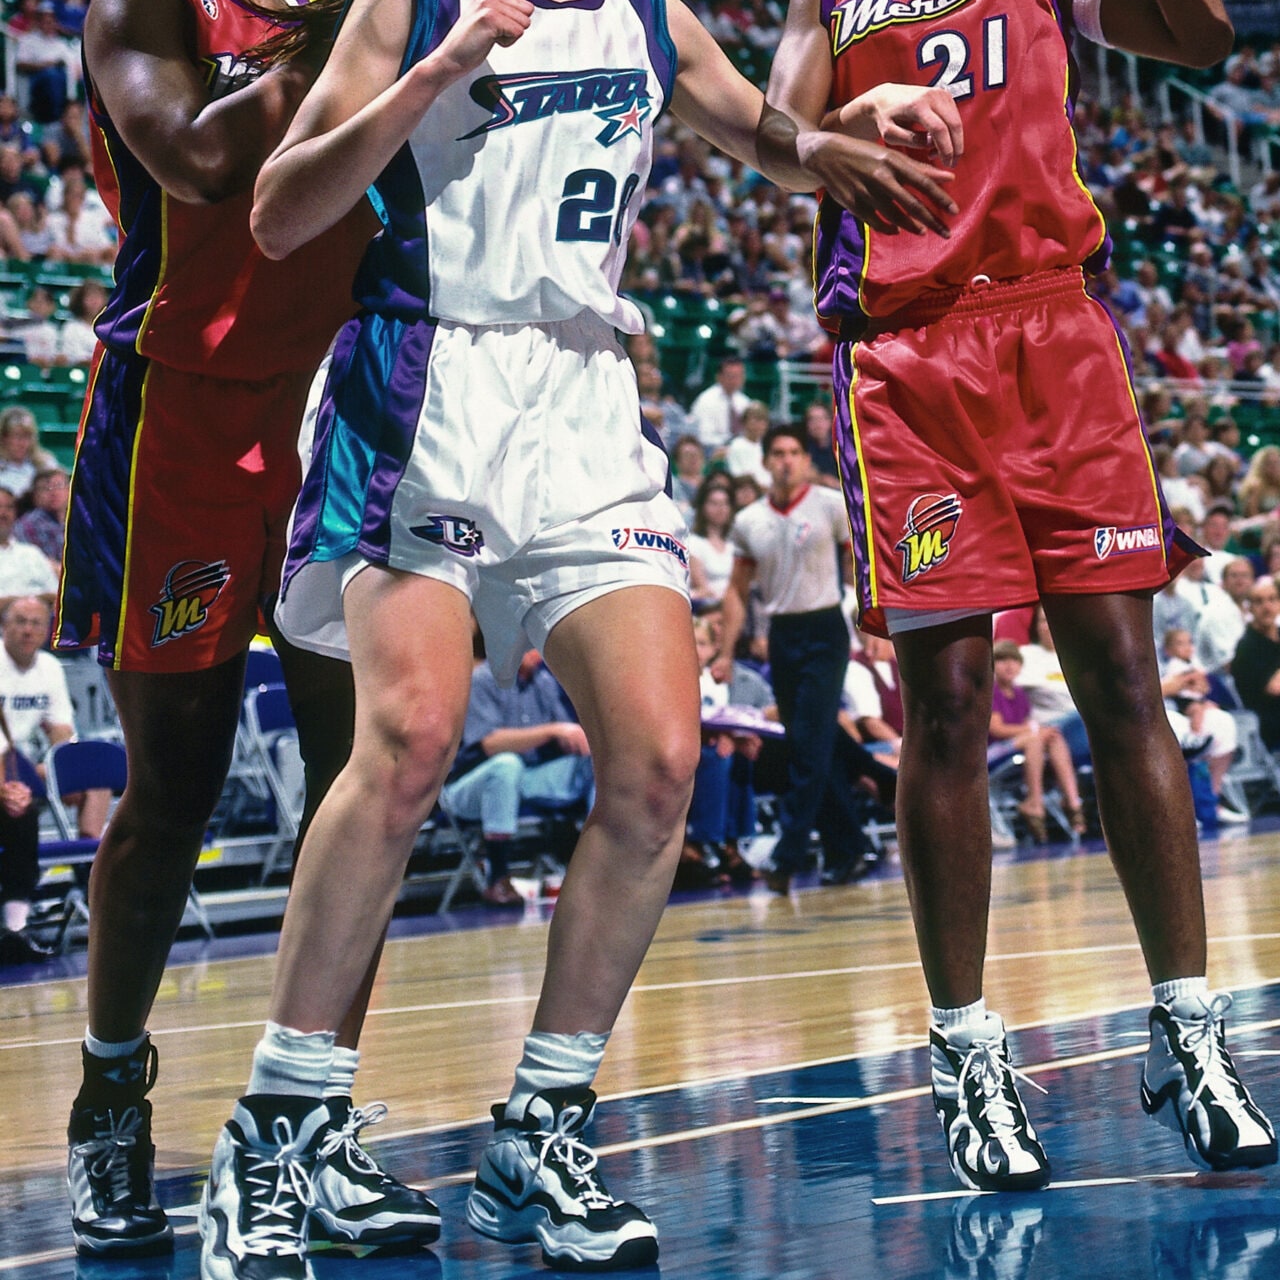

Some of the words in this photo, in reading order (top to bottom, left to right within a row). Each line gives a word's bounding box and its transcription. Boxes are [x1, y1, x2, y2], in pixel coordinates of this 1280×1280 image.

[917, 14, 1007, 102] 21
[456, 68, 654, 140] STARZZ
[633, 531, 687, 566] WNBA
[1116, 527, 1160, 551] WNBA
